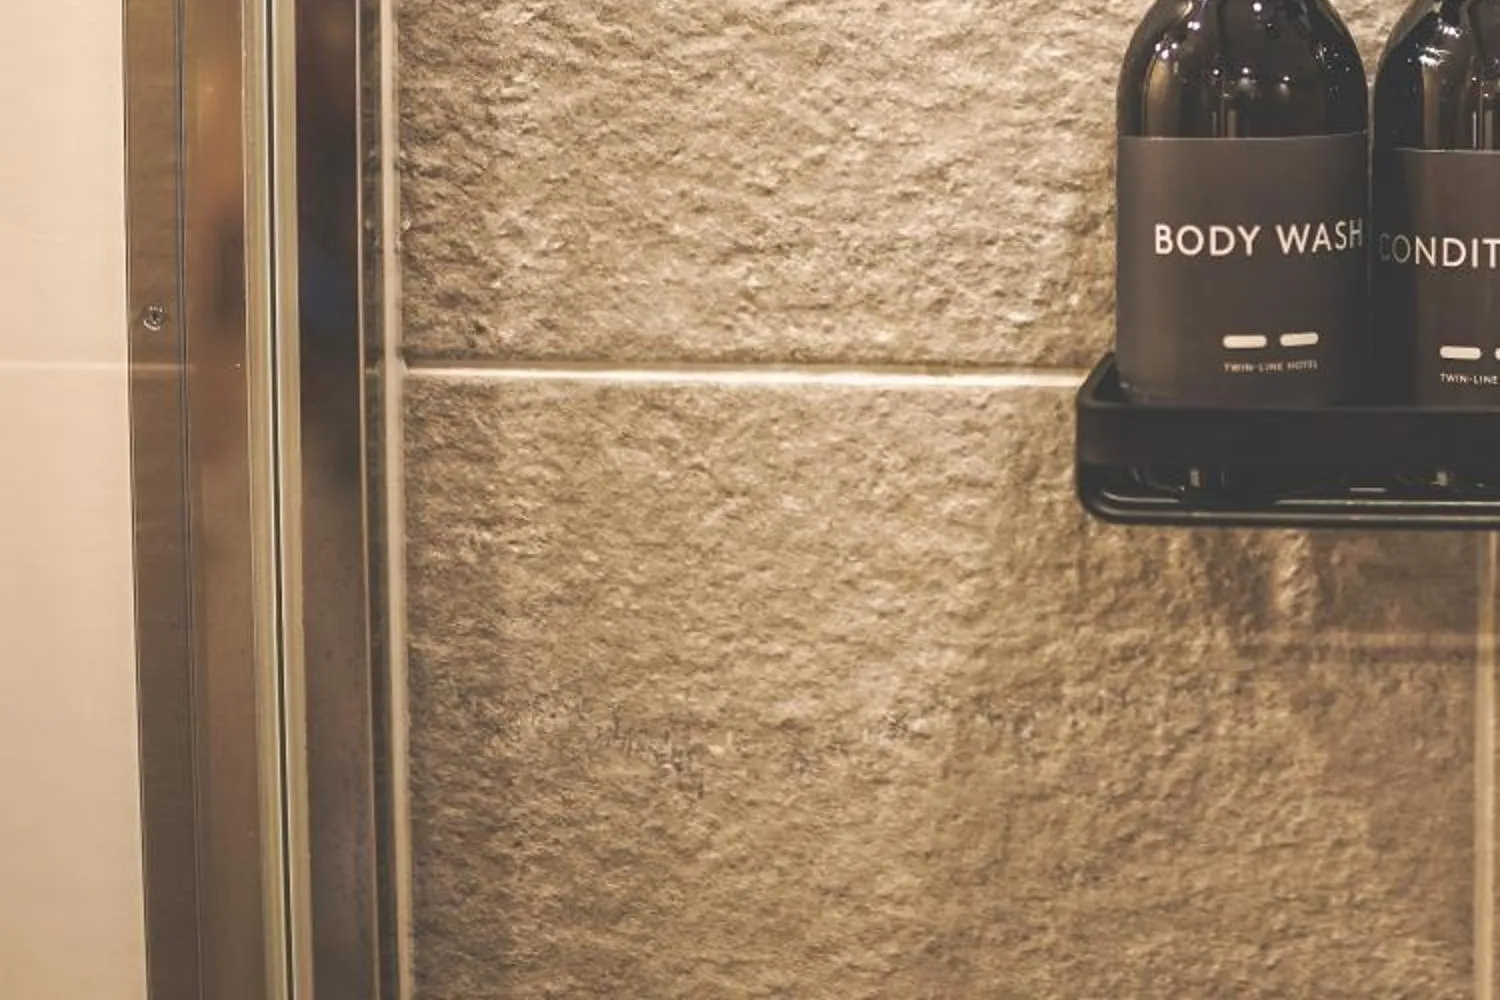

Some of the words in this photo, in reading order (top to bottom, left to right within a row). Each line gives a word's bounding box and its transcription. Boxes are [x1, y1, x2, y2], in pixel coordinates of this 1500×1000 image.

[1154, 223, 1261, 256] BODY
[1275, 217, 1363, 255] WASH
[1224, 362, 1283, 373] TWIN-LINE
[1287, 359, 1318, 371] HOTEL
[1440, 372, 1498, 385] TWIN-LINE
